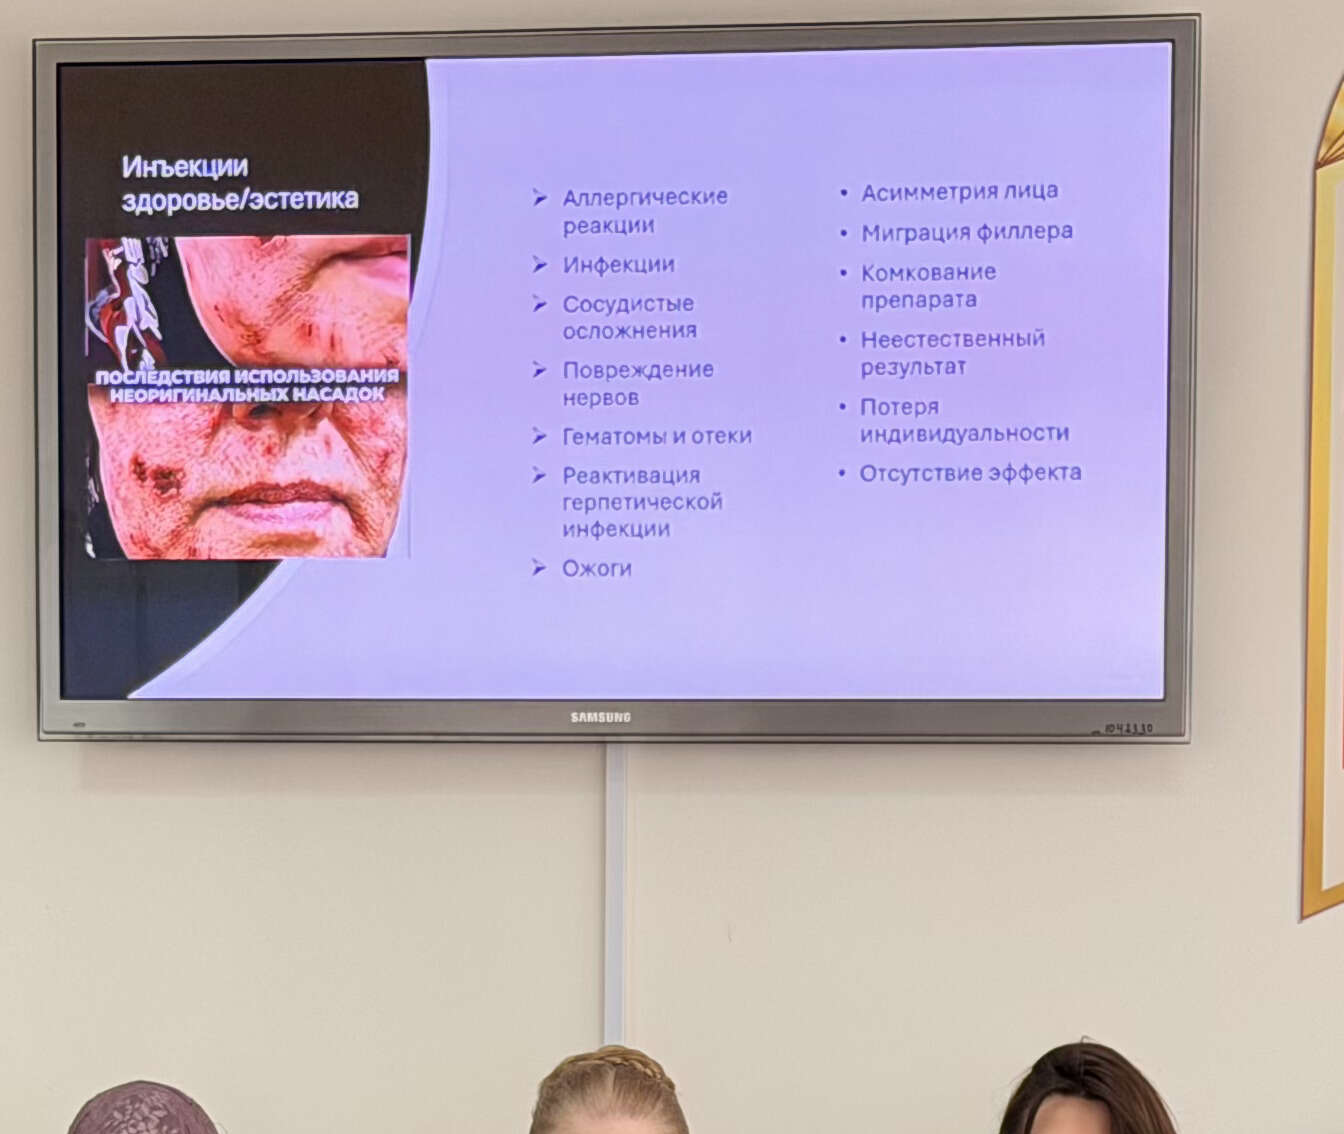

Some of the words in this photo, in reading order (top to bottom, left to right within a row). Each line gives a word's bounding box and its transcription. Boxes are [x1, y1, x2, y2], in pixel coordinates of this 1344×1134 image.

[122, 154, 249, 181] Инъекции
[121, 186, 359, 217] здоровье/эстетика
[563, 189, 728, 211] Аллергические
[861, 184, 999, 205] Асимметрия
[1004, 183, 1059, 201] лица
[563, 218, 655, 239] реакции
[862, 224, 971, 246] Миграция
[976, 223, 1073, 245] филлера
[563, 255, 675, 278] Инфекции
[862, 264, 997, 282] Комкование
[563, 295, 695, 318] Сосудистые
[861, 293, 977, 313] препарата
[563, 324, 697, 340] осложнения
[861, 328, 1045, 349] Неестественный
[95, 369, 231, 387] ПОСЛЕДСТВИЯ
[234, 368, 400, 388] ИСПОЛЬЗОВАНИЯ
[563, 360, 714, 383] Повреждение
[861, 359, 967, 380] результат
[109, 387, 290, 406] НЕОРИГИНАЛЬНЫХ
[292, 386, 386, 404] НАСАДОК
[563, 391, 640, 410] нервов
[860, 397, 939, 419] Потеря
[563, 427, 668, 446] Гематомы
[672, 430, 686, 444] и
[691, 429, 752, 445] отеки
[860, 426, 1070, 446] индивидуальности
[563, 465, 701, 486] Реактивация
[859, 463, 983, 487] Отсутствие
[988, 462, 1082, 486] эффекта
[562, 491, 723, 516] герпетической
[563, 519, 670, 541] инфекции
[562, 558, 632, 578] Ожоги
[570, 711, 632, 723] SAMSUNG
